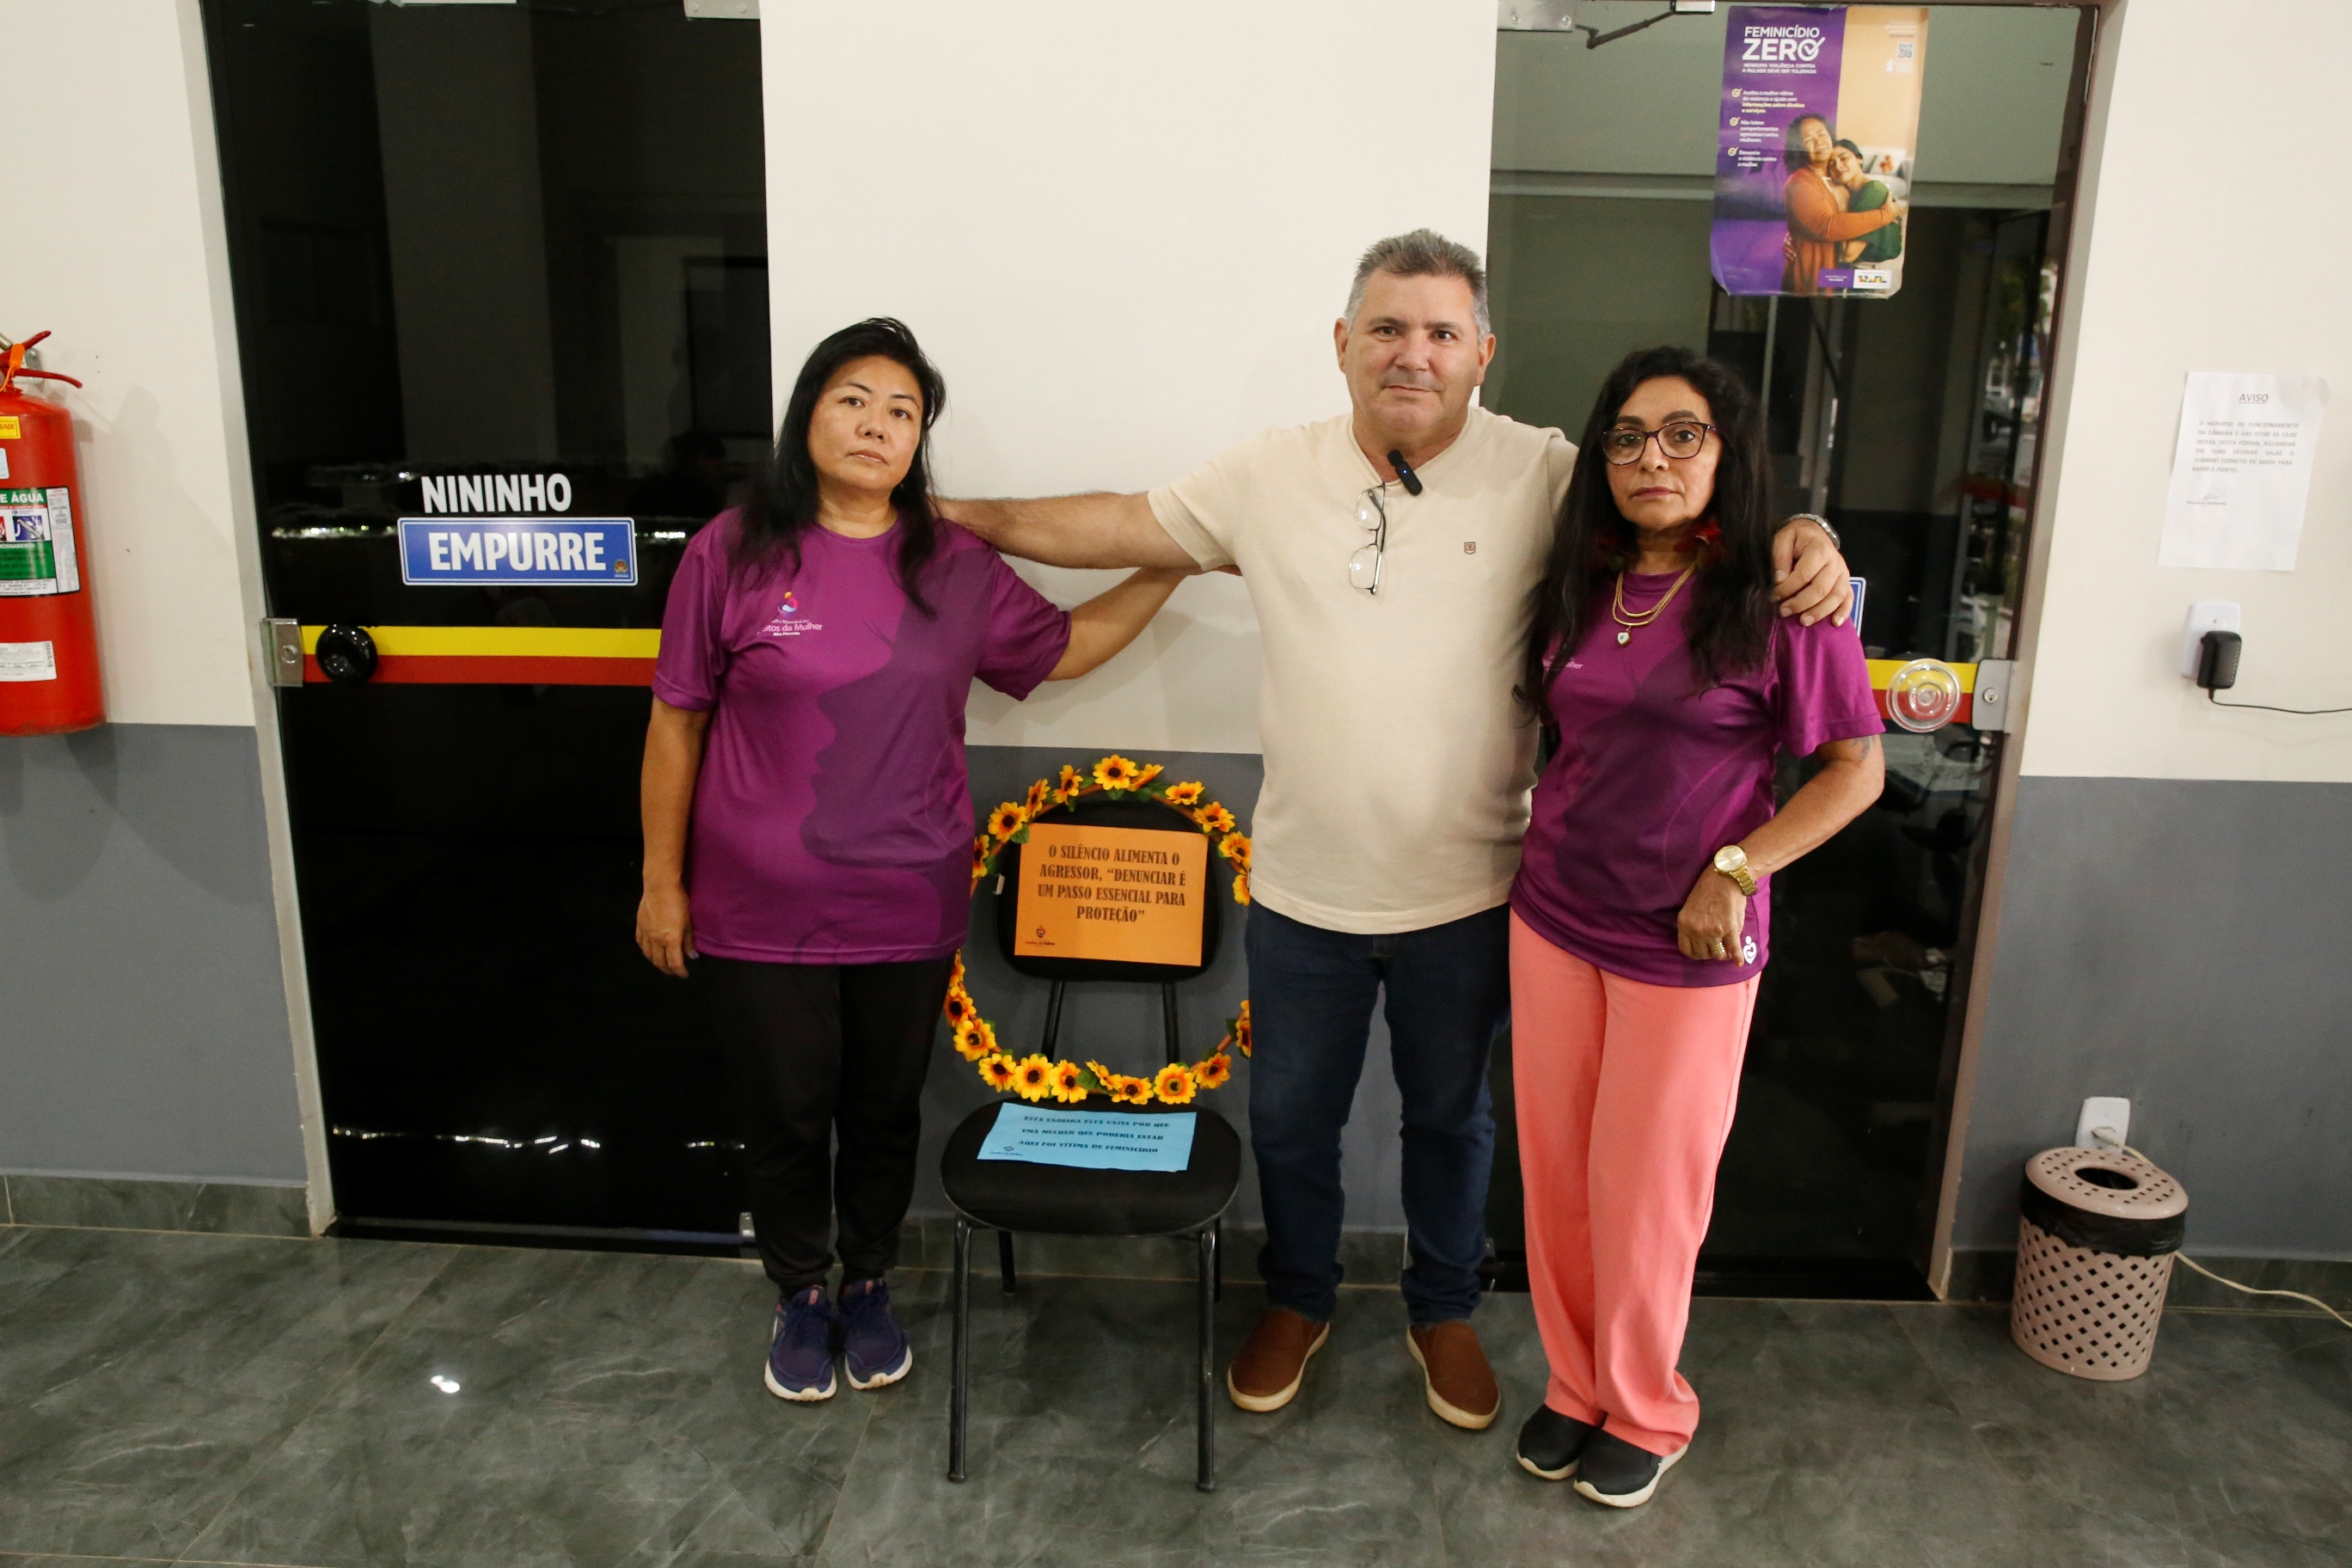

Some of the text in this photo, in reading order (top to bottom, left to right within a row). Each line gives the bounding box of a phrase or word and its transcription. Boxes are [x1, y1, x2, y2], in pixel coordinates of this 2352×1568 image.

[1744, 24, 1820, 38] FEMINICÍDIO
[1742, 37, 1825, 62] ZERO
[2238, 393, 2269, 404] AVISO
[0, 491, 44, 504] E ÁGUA
[421, 473, 572, 513] NININHO
[428, 532, 606, 571] EMPURRE
[794, 622, 823, 631] Mulher
[1049, 843, 1179, 865] O SILÊNCIO ALIMENTA O
[1040, 864, 1102, 882] AGRESSOR,
[1179, 870, 1186, 886] É
[1038, 884, 1186, 906] UM PASSO ESSENCIAL PARA
